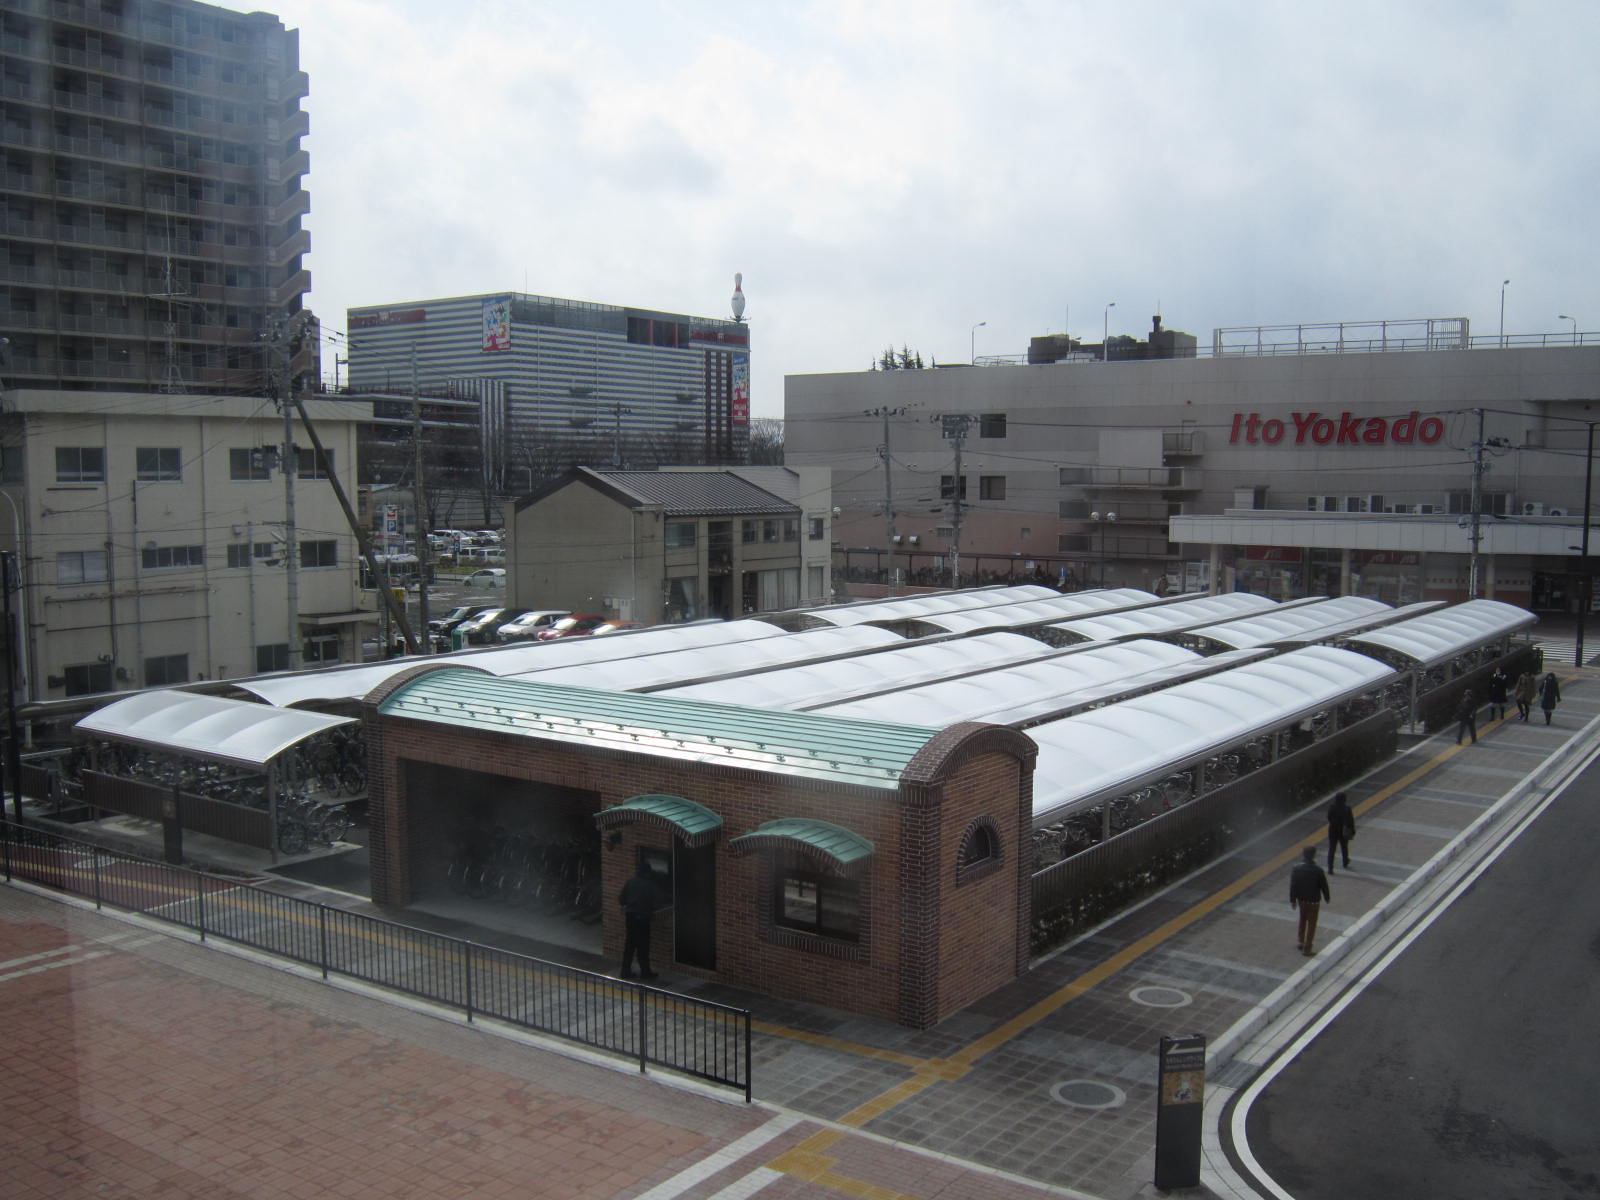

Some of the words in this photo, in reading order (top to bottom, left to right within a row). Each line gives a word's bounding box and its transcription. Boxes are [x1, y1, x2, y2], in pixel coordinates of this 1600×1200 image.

[1229, 413, 1284, 444] Ito
[1291, 411, 1444, 444] Yokado
[388, 520, 395, 531] P
